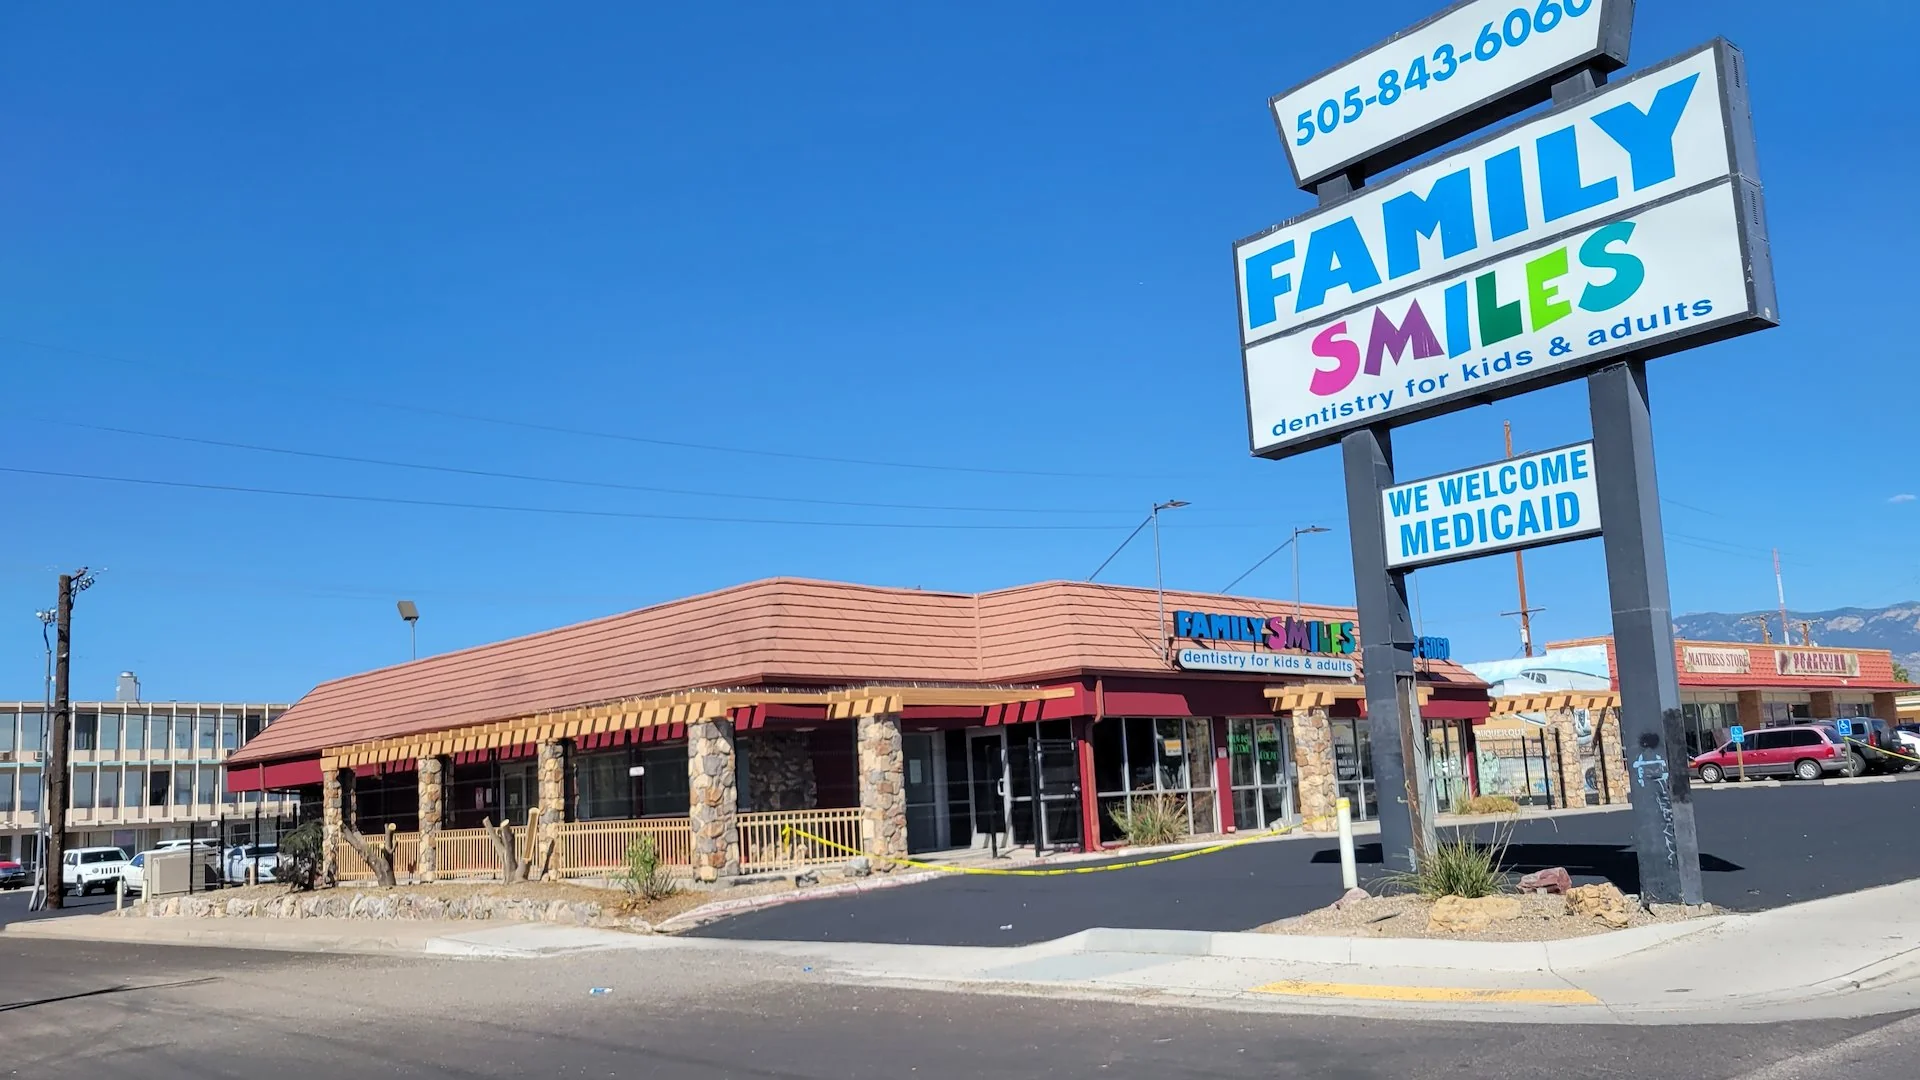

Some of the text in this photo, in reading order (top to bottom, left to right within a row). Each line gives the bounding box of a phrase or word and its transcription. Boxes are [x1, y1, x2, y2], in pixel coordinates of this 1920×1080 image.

[1245, 71, 1701, 330] FAMILY
[1309, 221, 1645, 396] SMILES
[1272, 299, 1714, 436] dentistry for kids & adults
[1388, 449, 1588, 518] WE WELCOME
[1400, 491, 1580, 558] MEDICAID
[1174, 611, 1357, 655] FAMILY SMILES
[1184, 650, 1353, 673] dentistry for kids & adults
[1688, 652, 1749, 667] MATTRESS STORE
